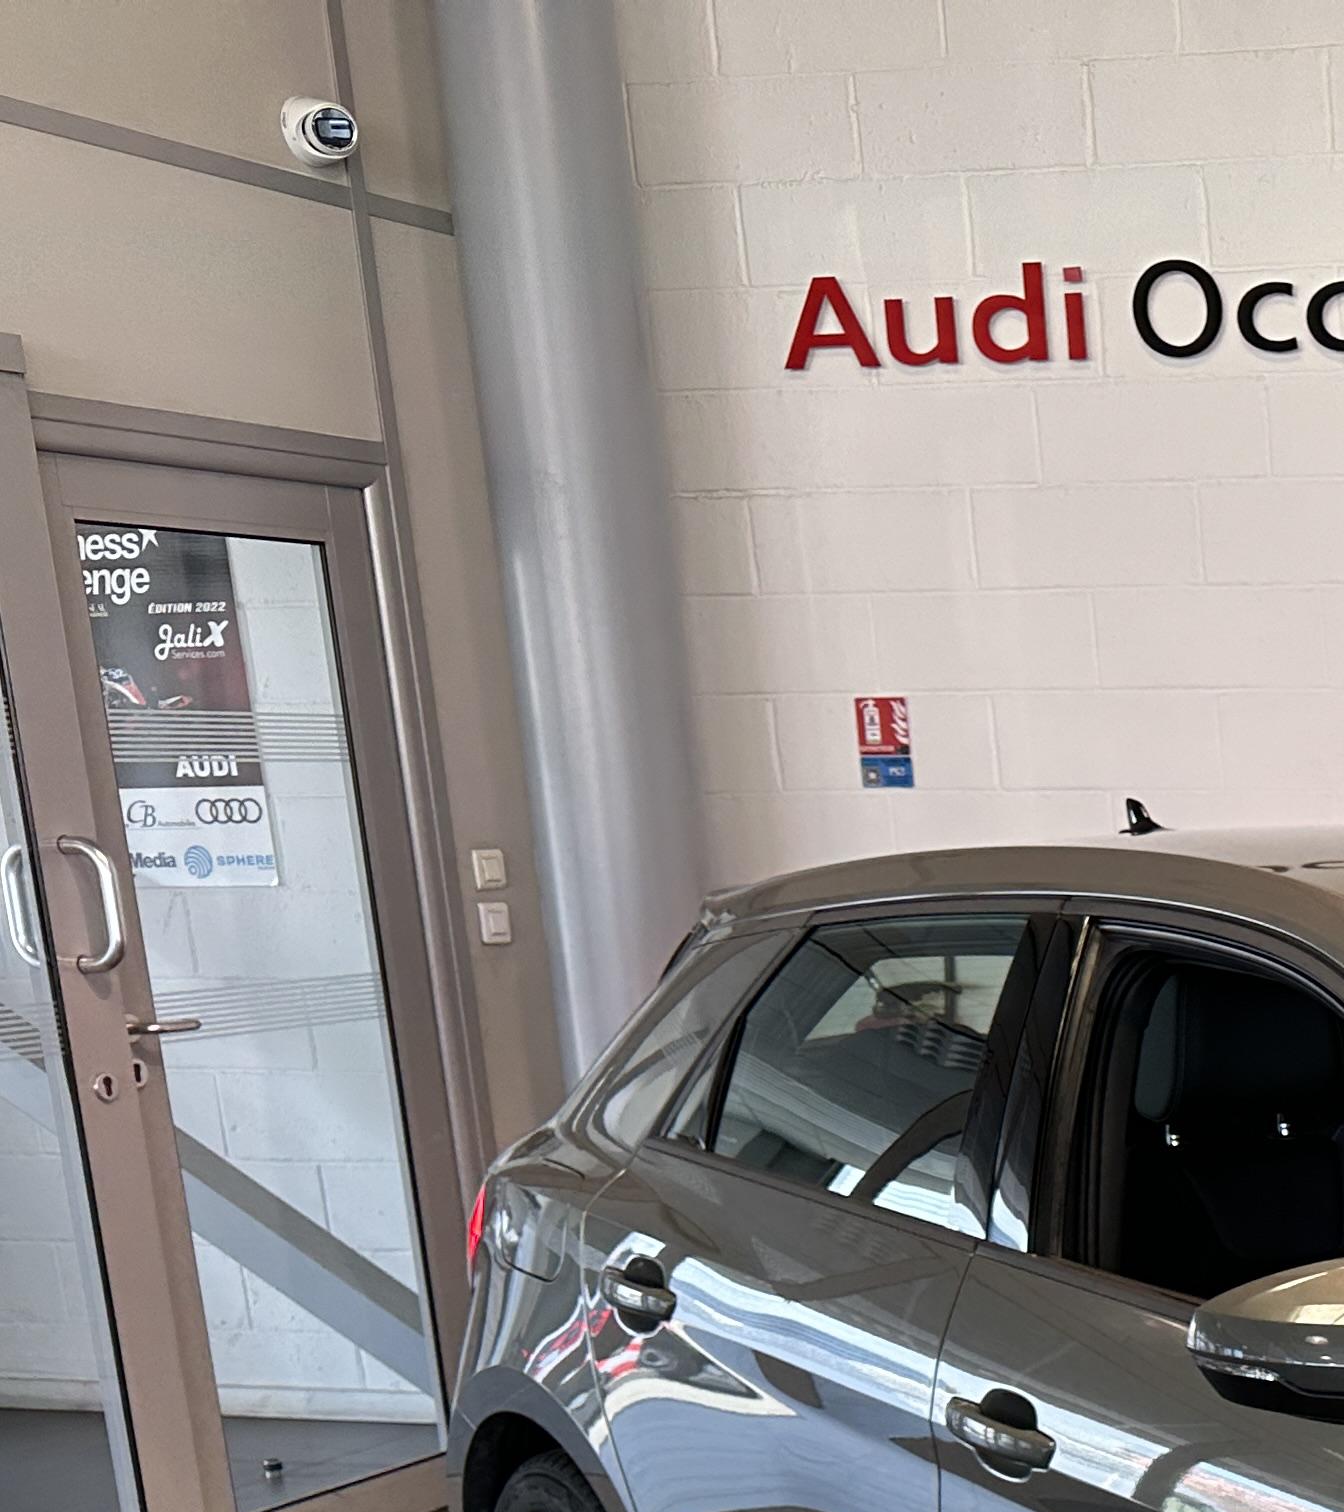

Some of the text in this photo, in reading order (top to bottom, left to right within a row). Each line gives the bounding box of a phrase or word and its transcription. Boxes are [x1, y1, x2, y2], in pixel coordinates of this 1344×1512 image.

[784, 261, 1090, 371] Audi
[195, 602, 226, 613] 2022
[176, 755, 239, 778] AUDI
[217, 855, 274, 867] SPHERE
